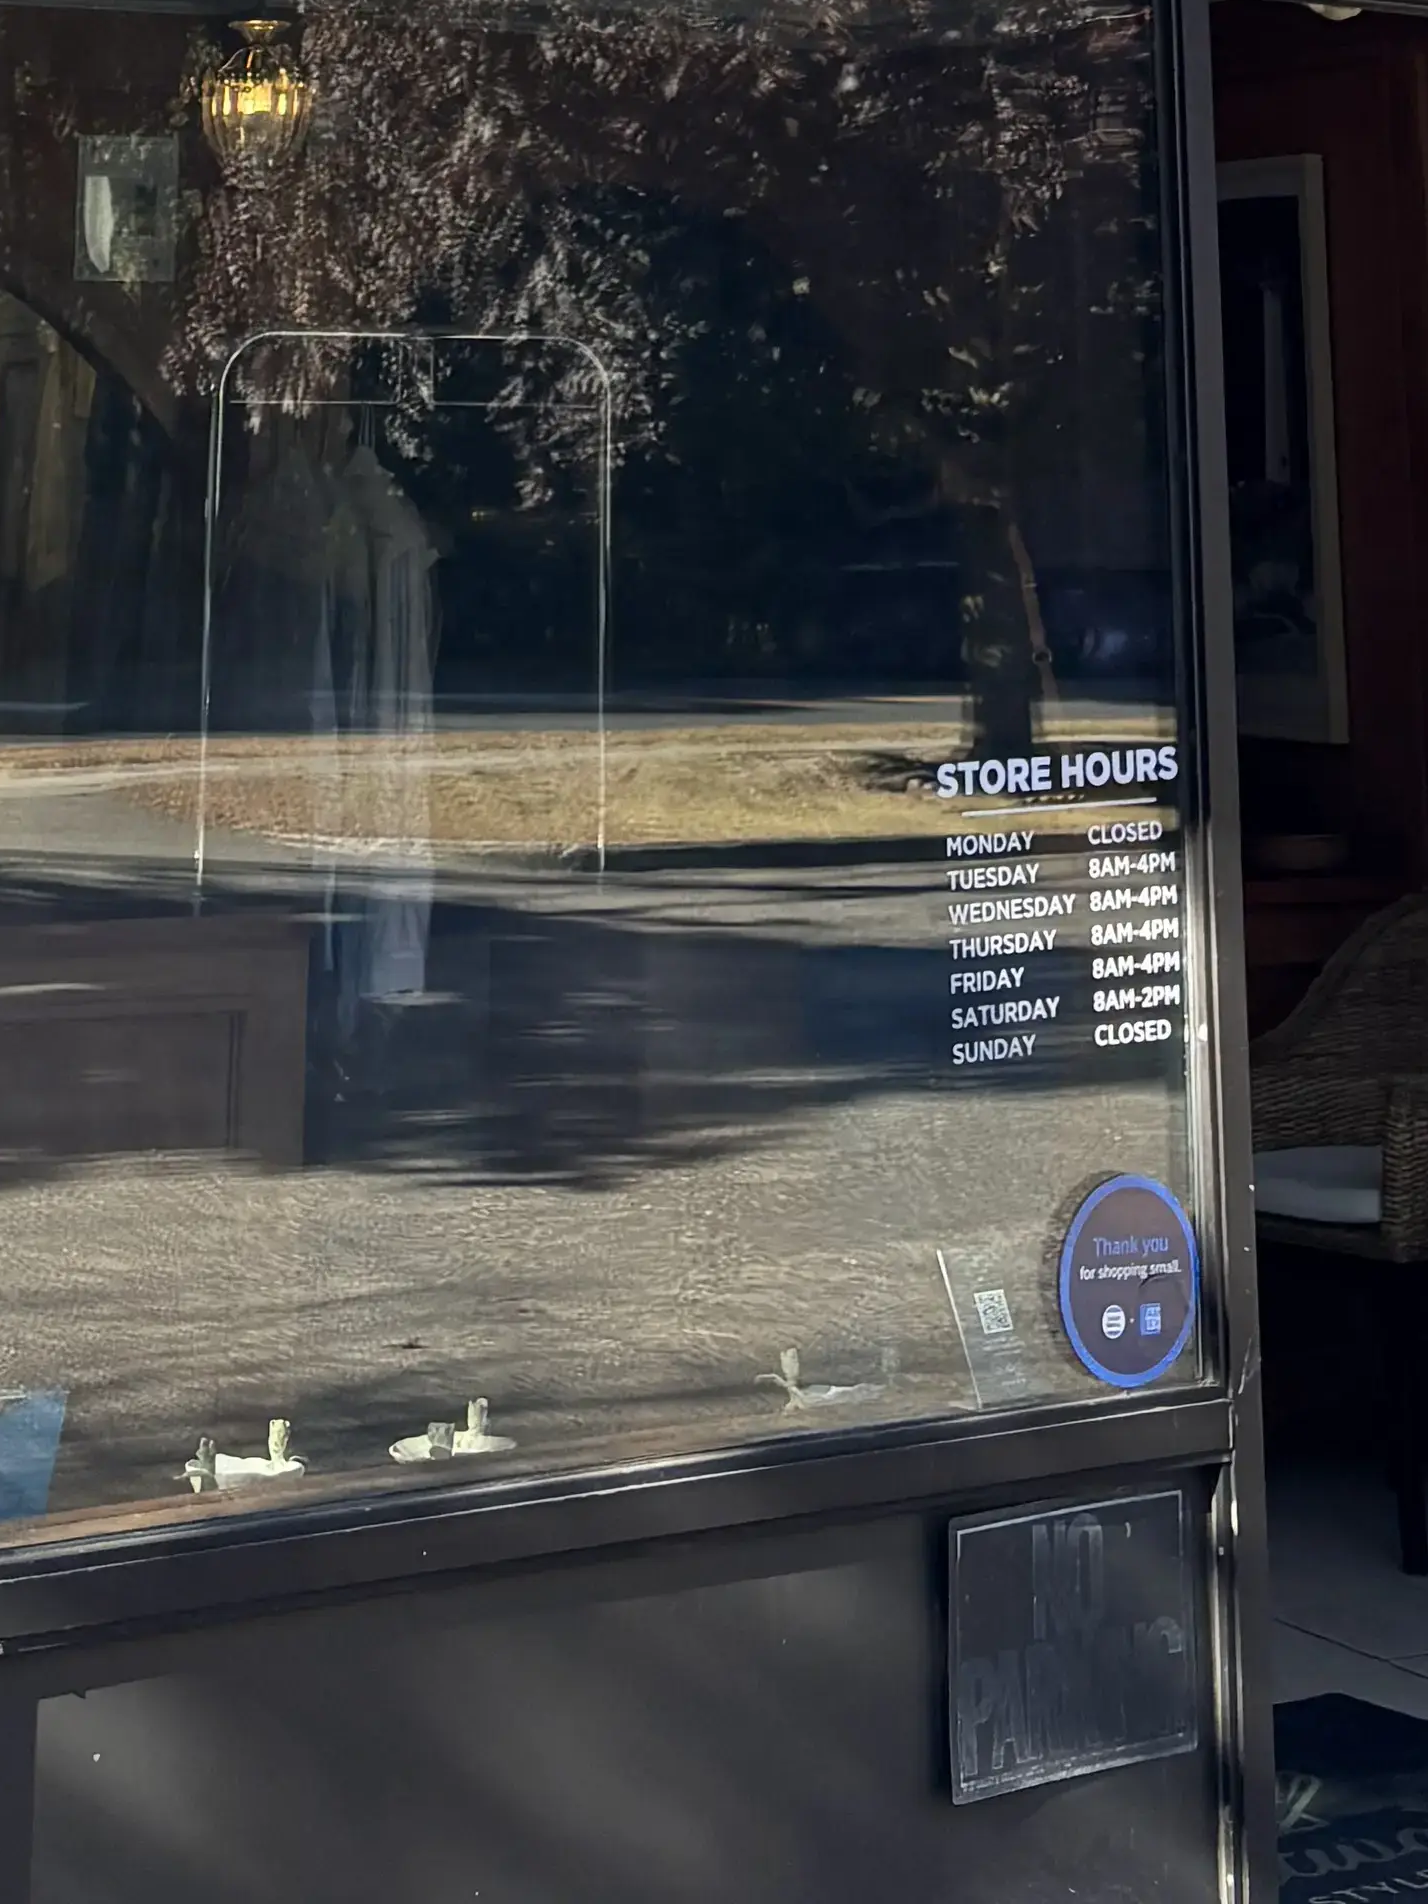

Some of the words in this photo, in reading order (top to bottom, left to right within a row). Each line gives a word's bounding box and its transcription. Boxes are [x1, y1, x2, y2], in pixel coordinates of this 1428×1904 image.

[935, 755, 1052, 799] STORE
[1060, 745, 1179, 789] HOURS
[945, 830, 1034, 857] MONDAY
[1087, 820, 1163, 845] CLOSED
[947, 863, 1040, 891] TUESDAY
[1088, 851, 1176, 879] 8AM-4PM
[948, 893, 1076, 926] WEDNESDAY
[1089, 884, 1178, 912] 8AM-4PM
[949, 929, 1057, 960] THURSDAY
[1090, 917, 1179, 946] 8AM-4PM
[950, 966, 1025, 995] FRIDAY
[1092, 950, 1181, 980] 8AM-4PM
[951, 995, 1060, 1030] SATURDAY
[1092, 984, 1181, 1012] 8AM-2PM
[952, 1033, 1036, 1065] SUNDAY
[1093, 1018, 1172, 1047] CLOSED
[1092, 1235, 1139, 1259] Thank
[1142, 1236, 1169, 1259] you
[1079, 1265, 1095, 1281] for
[1097, 1262, 1148, 1281] shopping
